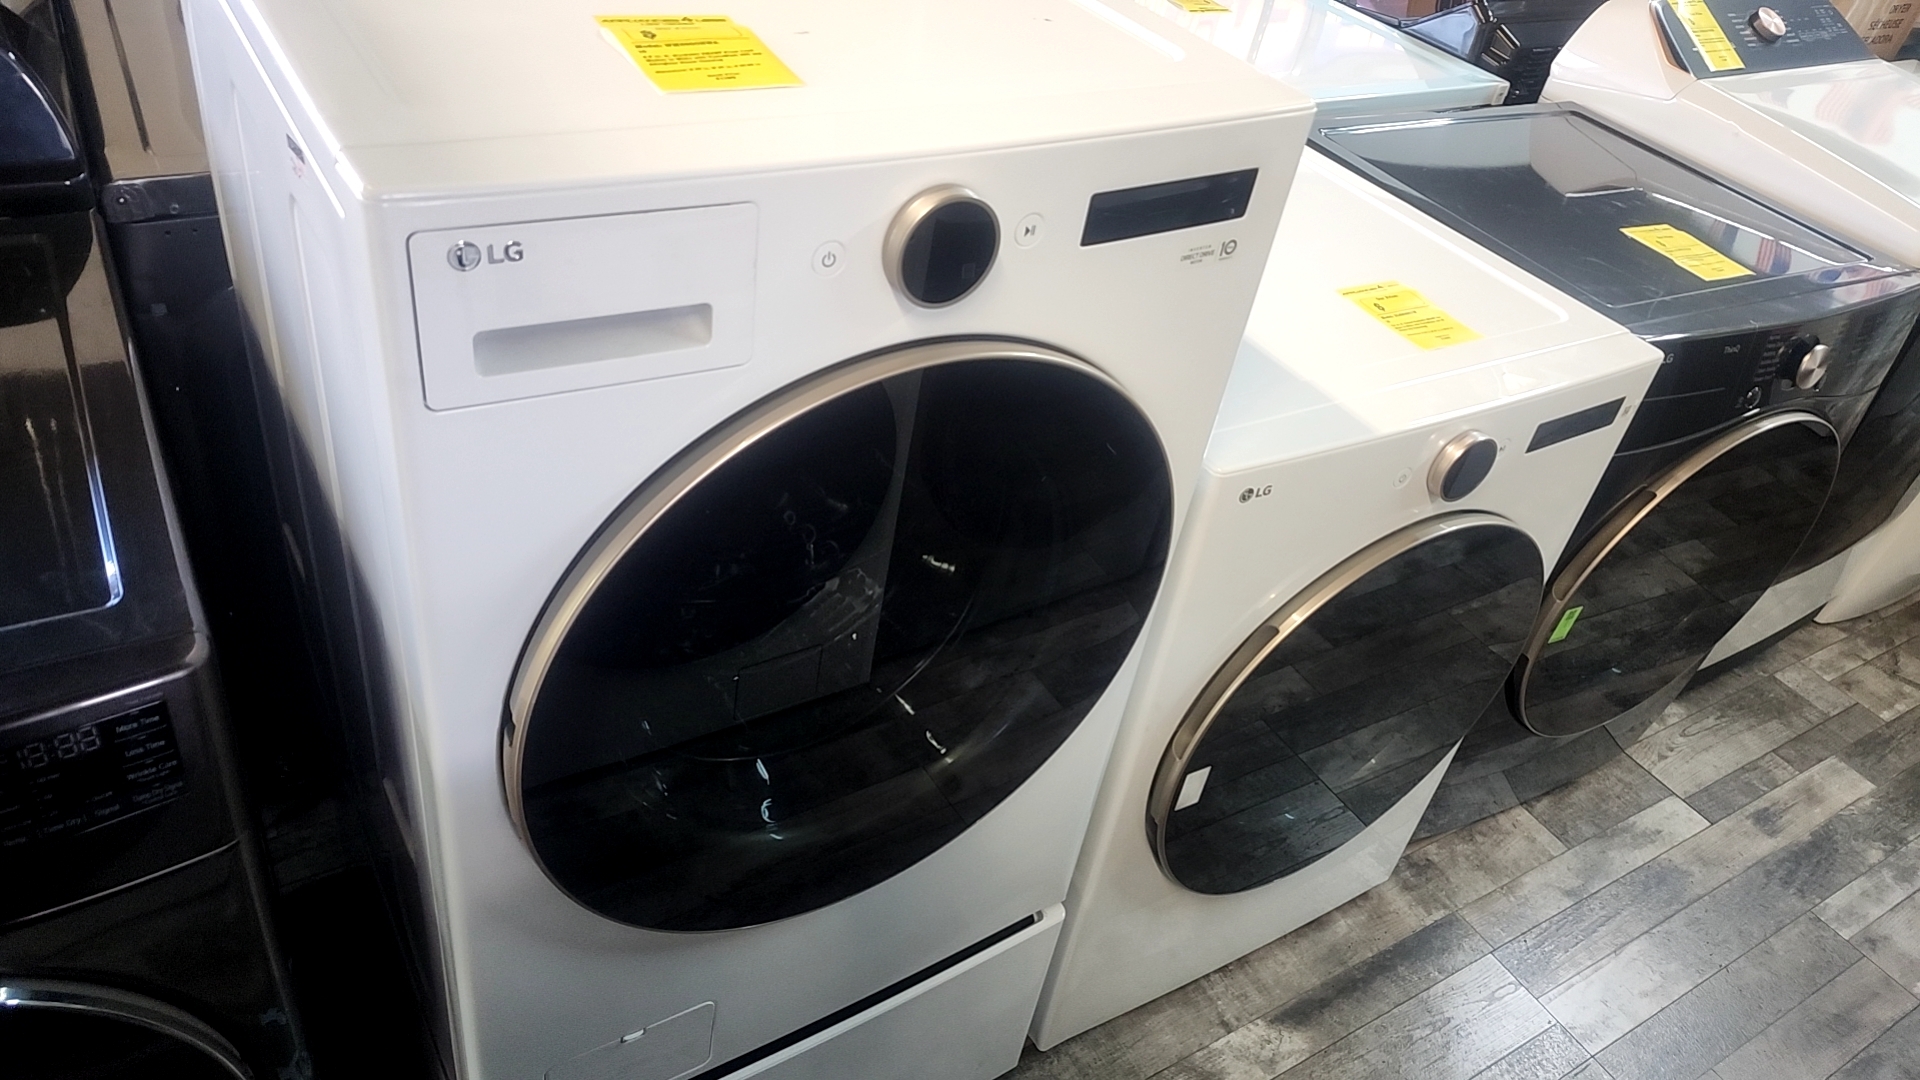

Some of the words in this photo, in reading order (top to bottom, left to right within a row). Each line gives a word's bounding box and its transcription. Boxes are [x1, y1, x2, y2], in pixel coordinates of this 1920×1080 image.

[486, 240, 524, 265] LG
[1255, 485, 1273, 499] LG
[115, 722, 139, 734] More
[140, 715, 160, 726] Time
[125, 746, 145, 757] Less
[145, 740, 166, 751] Time
